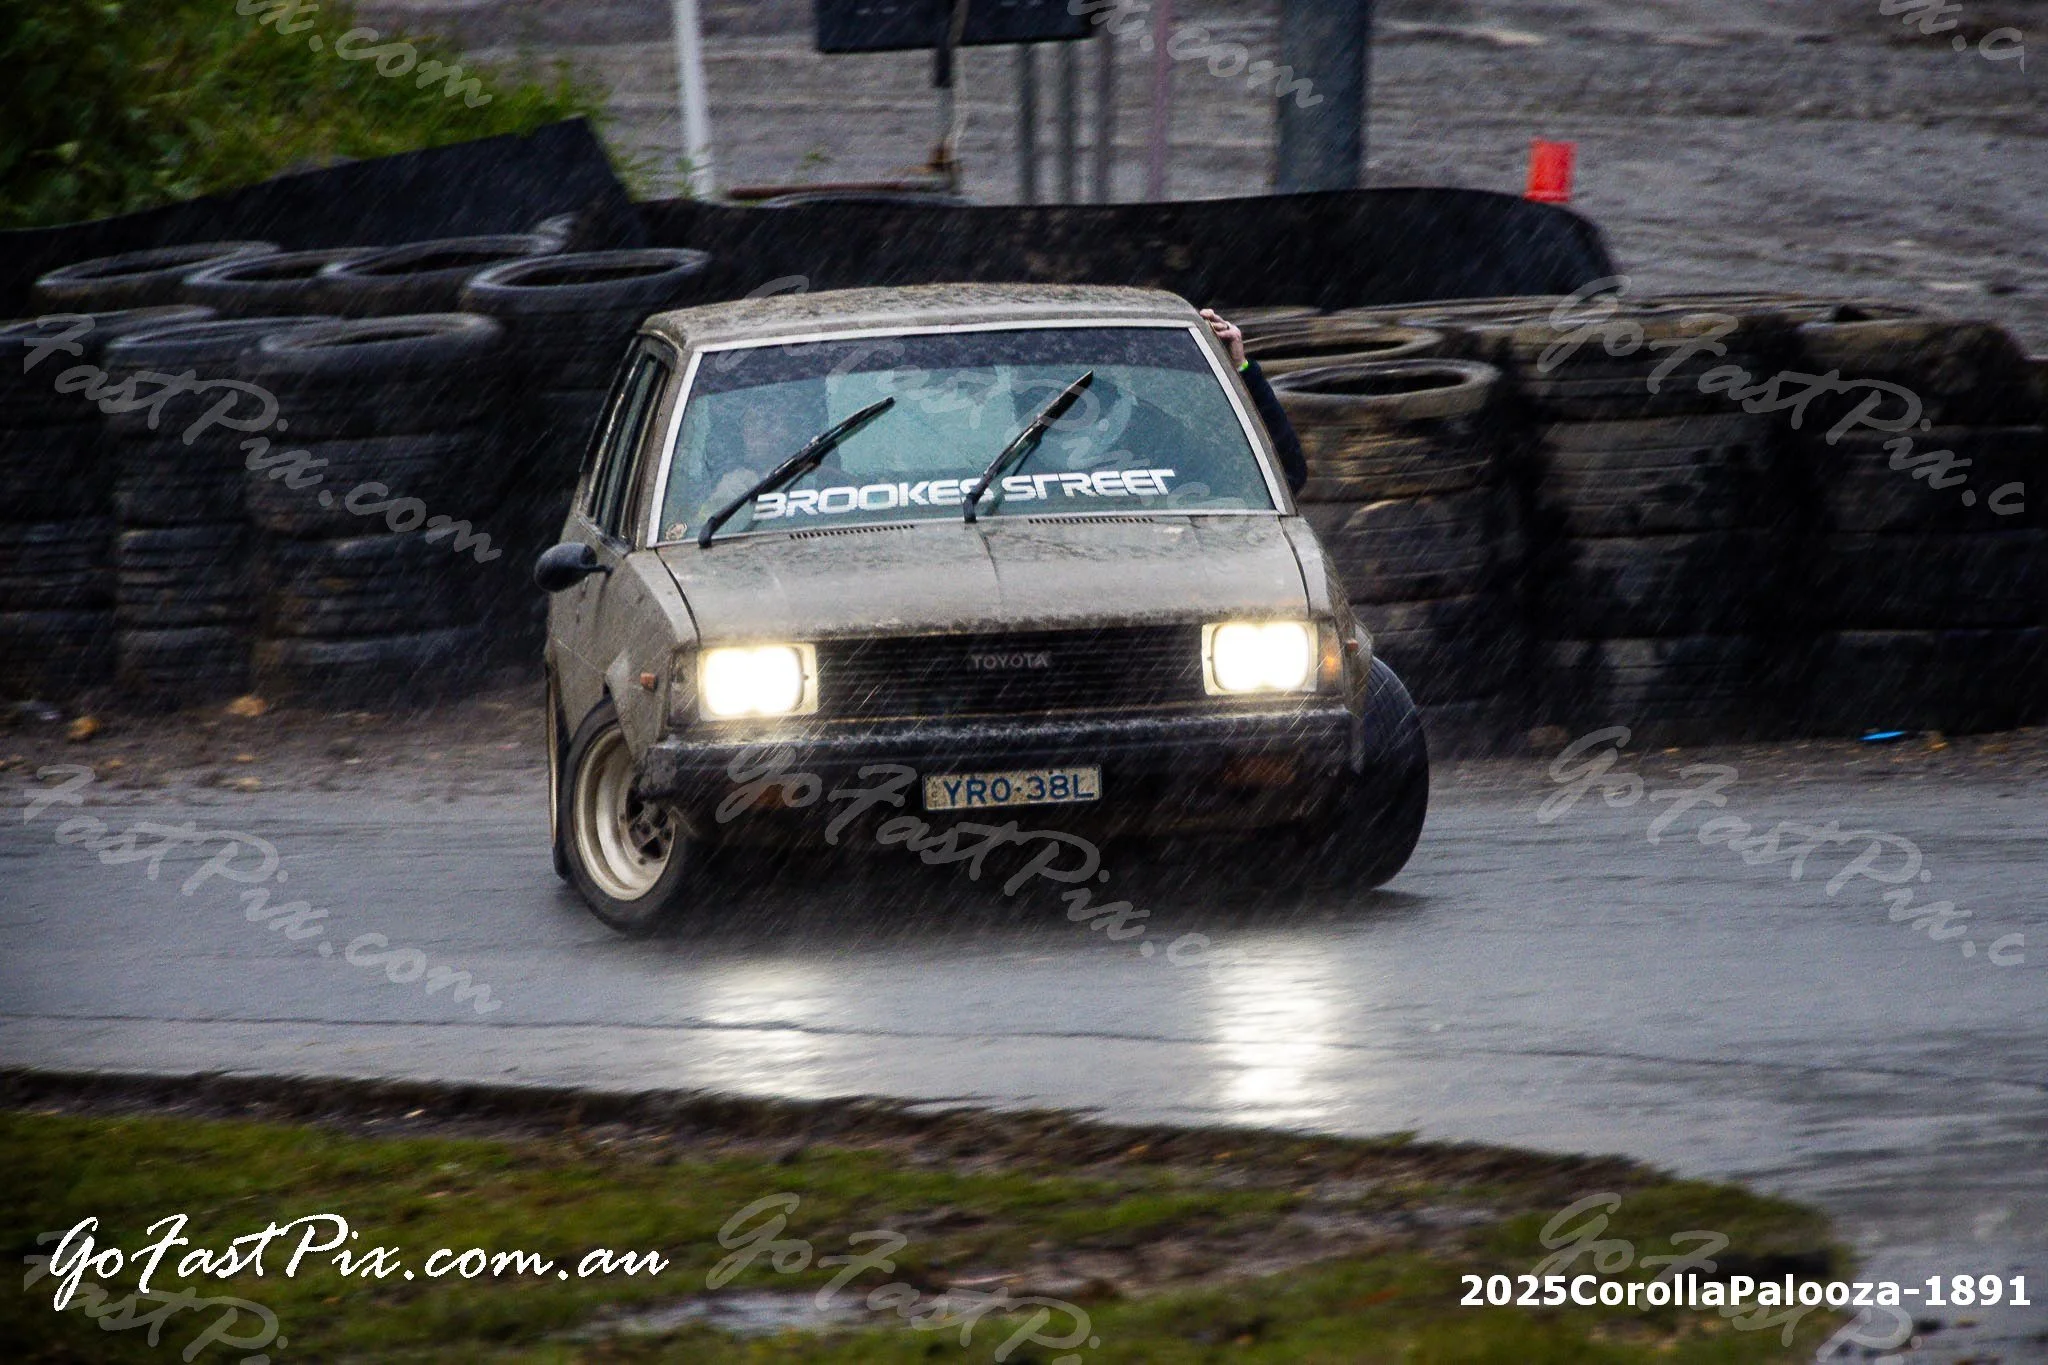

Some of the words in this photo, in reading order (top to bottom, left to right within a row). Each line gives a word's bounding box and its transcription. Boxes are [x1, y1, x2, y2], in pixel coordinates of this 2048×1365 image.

[753, 478, 993, 519] BROOKES
[1002, 469, 1175, 501] STREET
[971, 651, 1049, 669] TOYOTA
